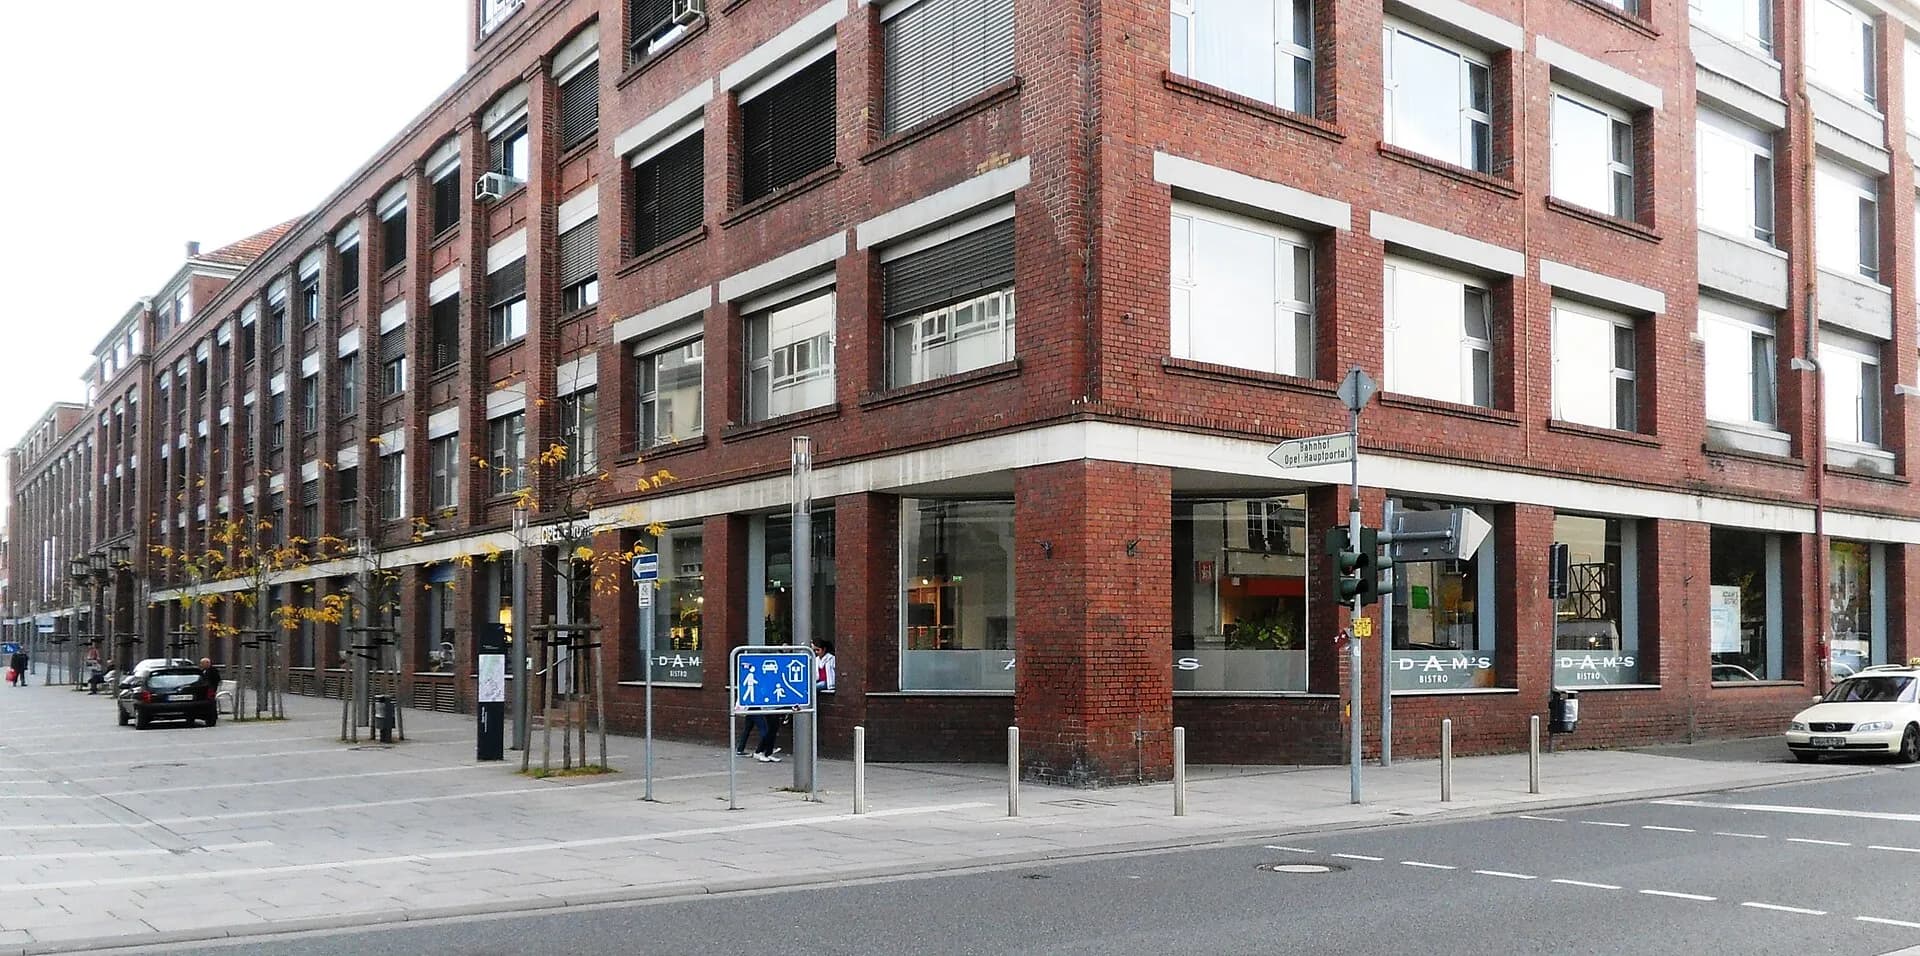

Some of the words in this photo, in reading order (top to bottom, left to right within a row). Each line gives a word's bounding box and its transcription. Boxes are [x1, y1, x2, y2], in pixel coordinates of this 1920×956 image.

[1300, 440, 1330, 452] Bahnhof
[1399, 656, 1491, 671] DAM'S
[1560, 655, 1635, 669] DAM'S
[1419, 675, 1448, 683] BISTRO
[1576, 672, 1600, 680] BISTRO
